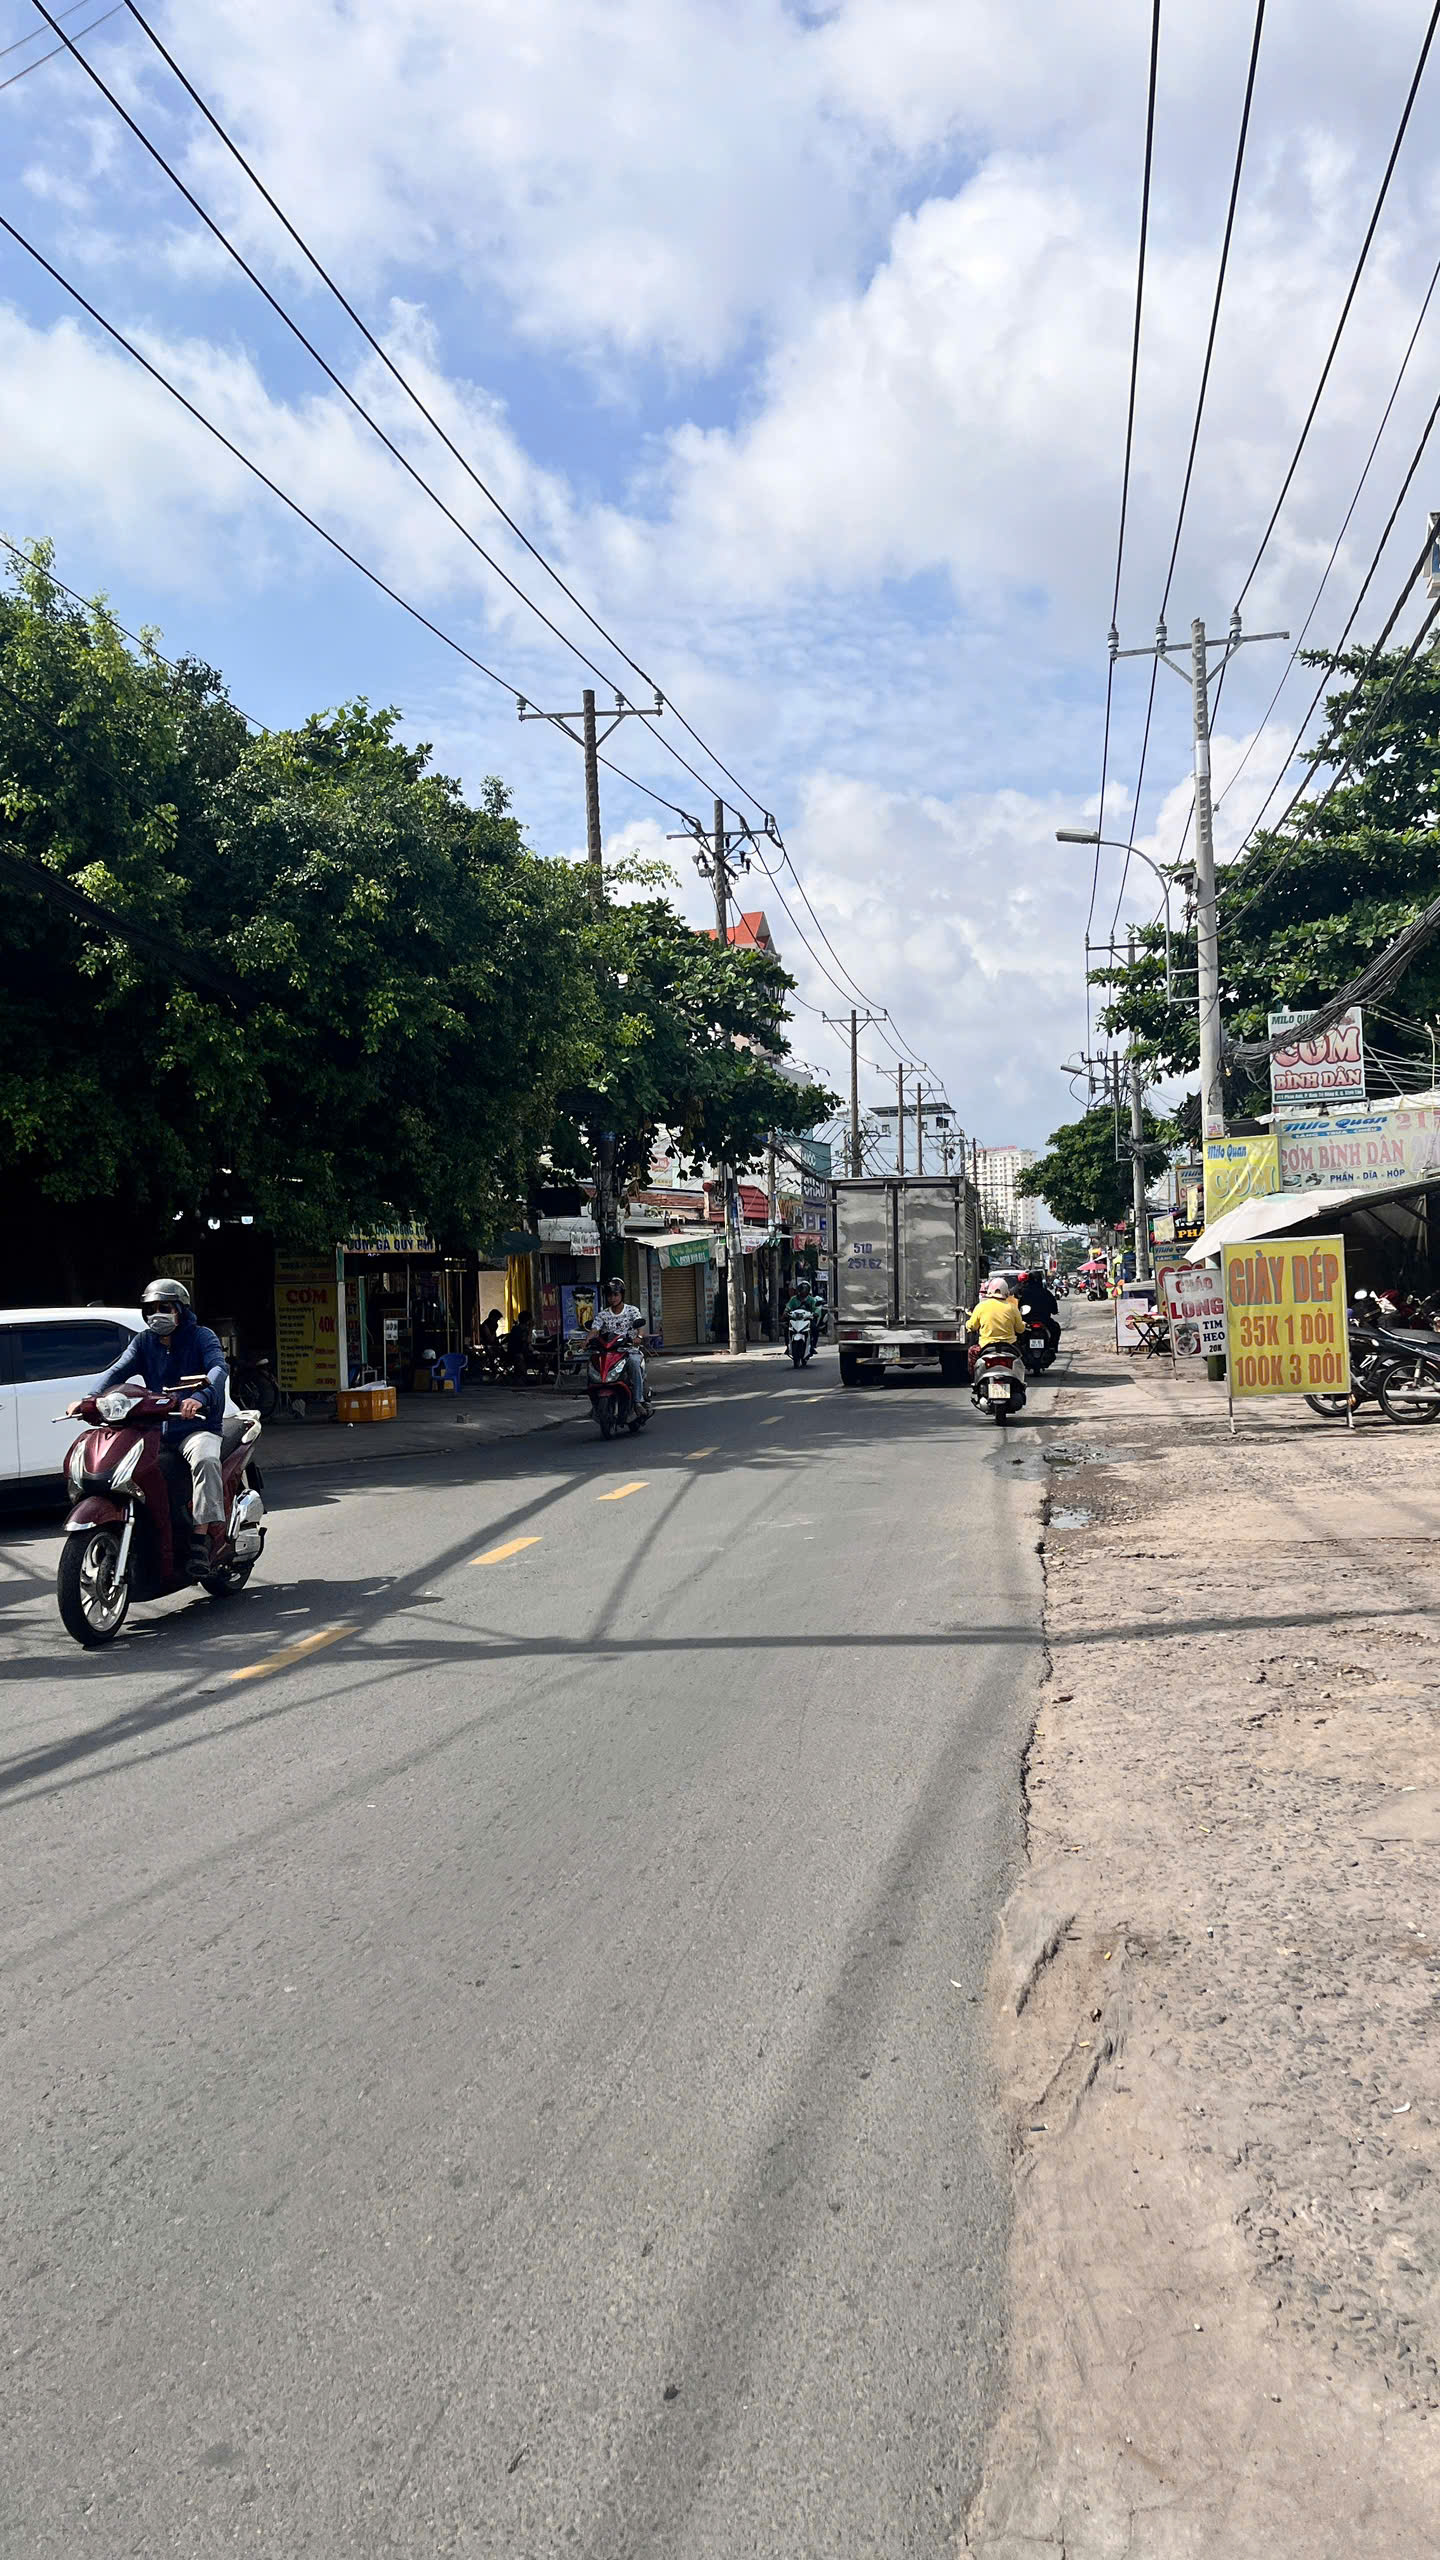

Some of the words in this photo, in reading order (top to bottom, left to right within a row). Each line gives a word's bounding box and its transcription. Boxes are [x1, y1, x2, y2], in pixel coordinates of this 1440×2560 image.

[1271, 1015, 1294, 1025] MILO
[1274, 1070, 1320, 1091] BÌNH
[1321, 1066, 1362, 1087] DÂN
[1283, 1120, 1330, 1132] Milo
[1207, 1144, 1225, 1159] Milo
[1318, 1139, 1362, 1169] BÌNH
[1366, 1134, 1404, 1165] DÂN
[1229, 1250, 1285, 1307] GIÀY
[1292, 1246, 1339, 1304] DÉP
[1203, 1319, 1223, 1330] TIM
[1240, 1315, 1280, 1347] 35K
[1284, 1314, 1295, 1345] 1
[1300, 1307, 1335, 1345] ĐÔI
[1203, 1331, 1225, 1342] HEO
[1235, 1354, 1285, 1387] 100K
[1289, 1353, 1302, 1385] 3
[1308, 1347, 1343, 1384] ĐÔI
